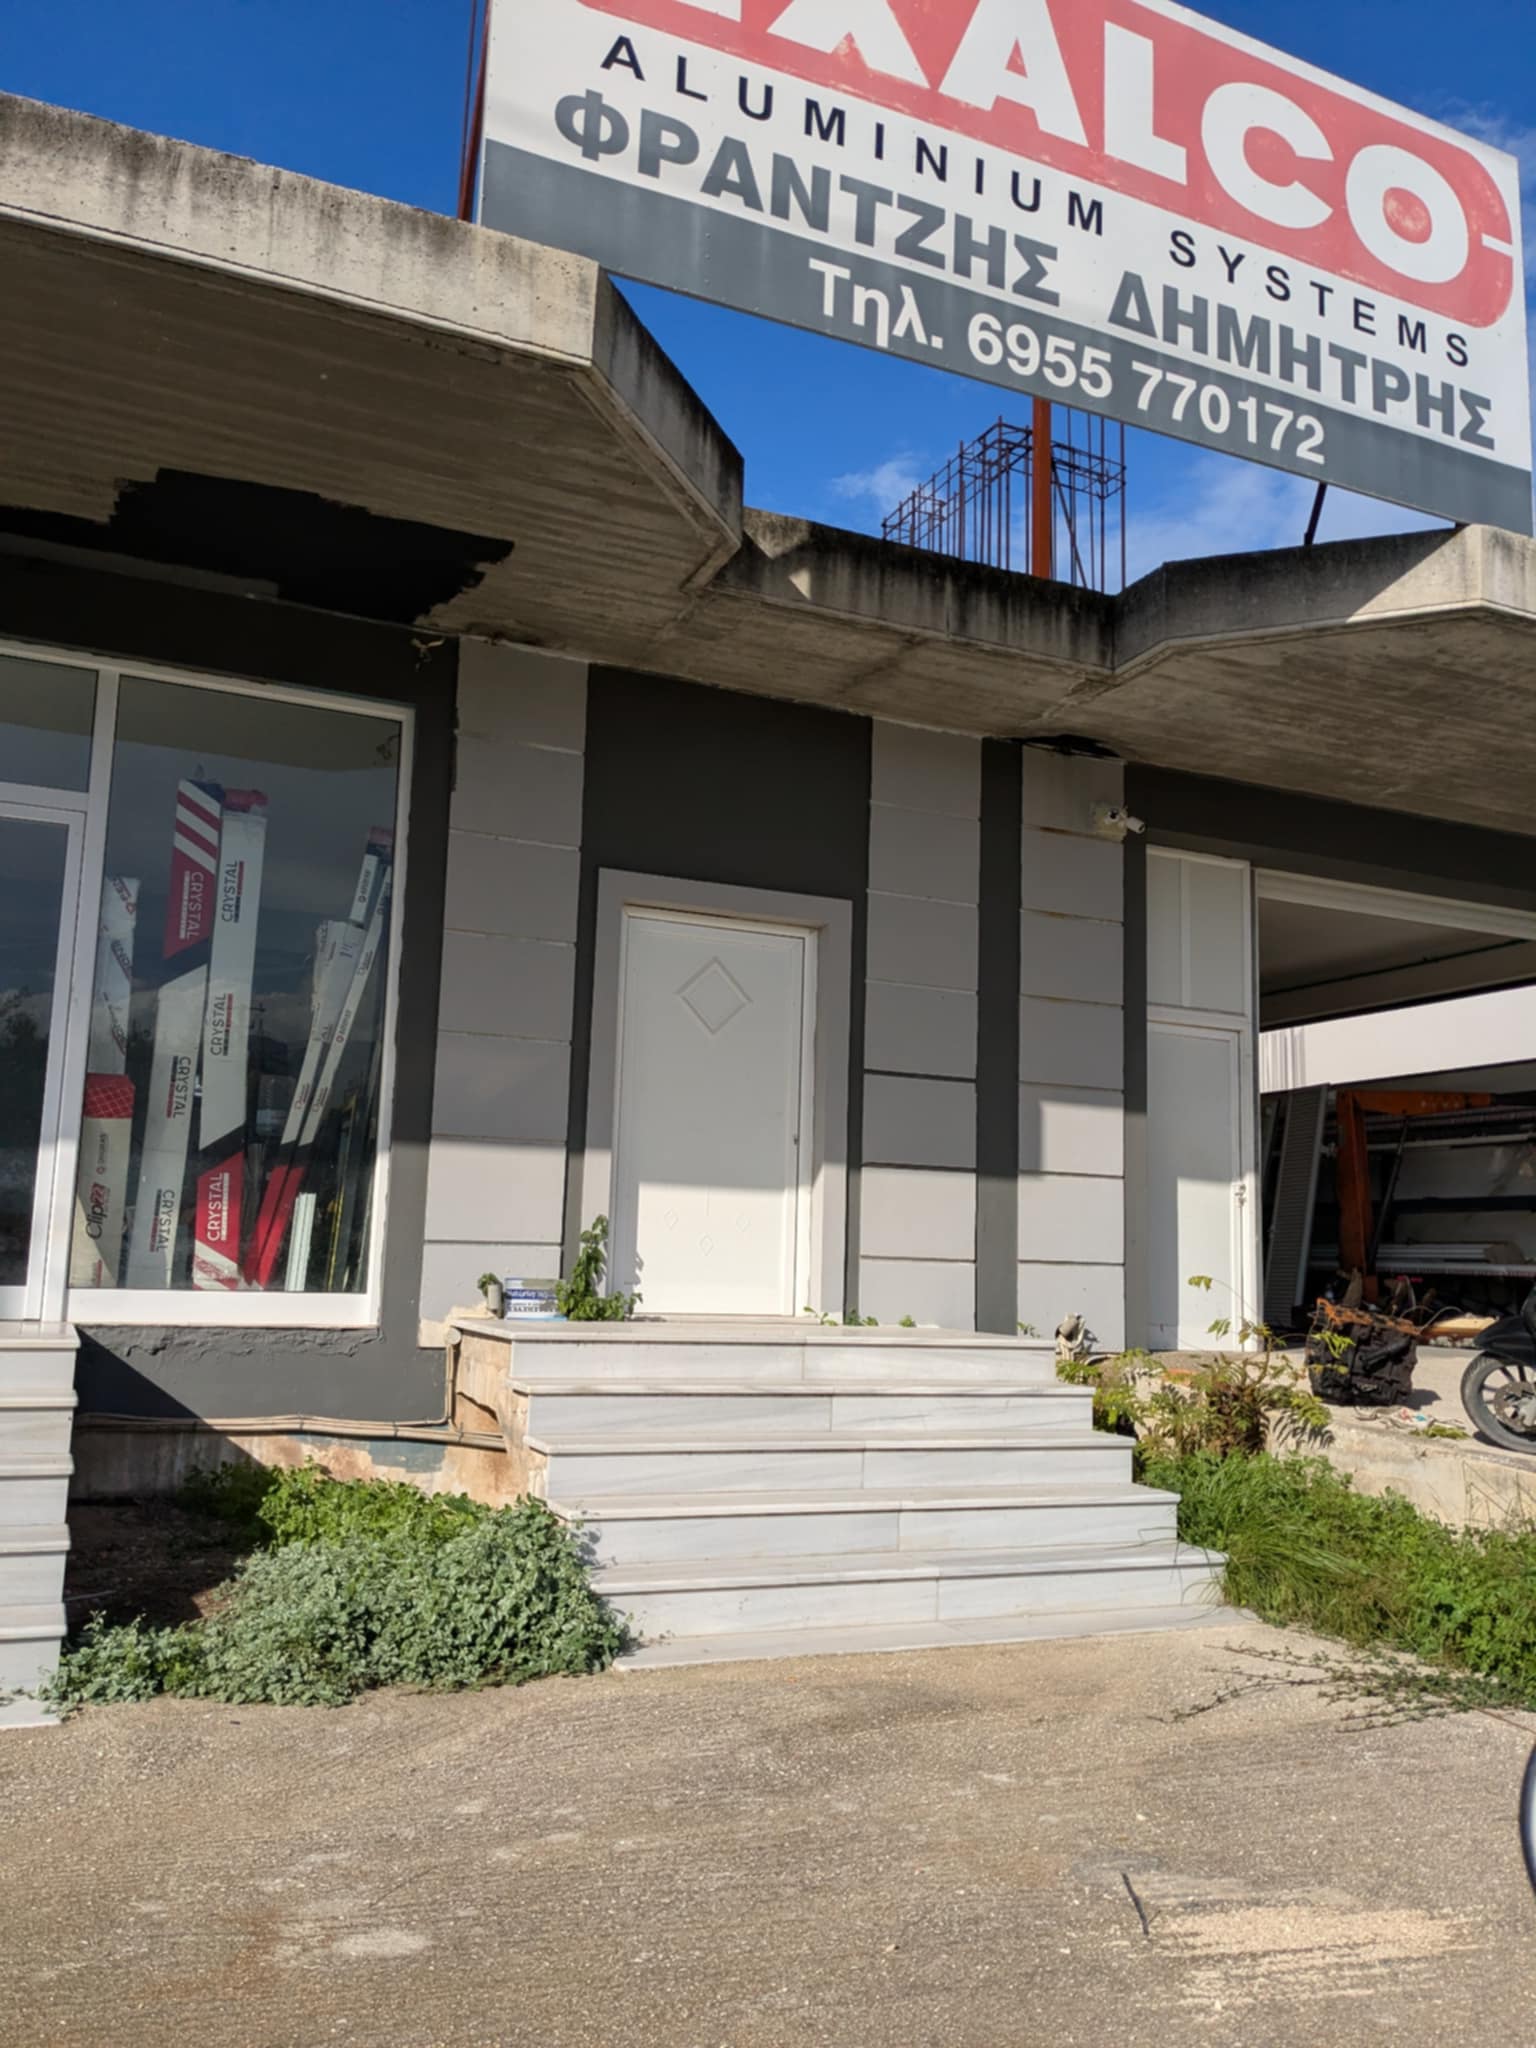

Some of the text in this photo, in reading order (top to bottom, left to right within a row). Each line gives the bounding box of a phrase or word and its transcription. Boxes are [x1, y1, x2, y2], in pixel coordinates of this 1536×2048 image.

[600, 35, 1469, 367] ALUMINIUM SYSTEMS
[554, 89, 1496, 451] ΦΡΑΝΤΖΗΣ ΔΗΜΗΤΡΗΣ
[808, 257, 1326, 465] Τηλ. 6955 770172
[187, 871, 204, 939] CRYSTAL
[222, 860, 239, 922] CRYSTAL
[210, 993, 227, 1055] CRYSTAL
[172, 1056, 191, 1118] CRYSTAL
[156, 1189, 176, 1252] CRYSTAL
[207, 1173, 224, 1242] CRYSTAL
